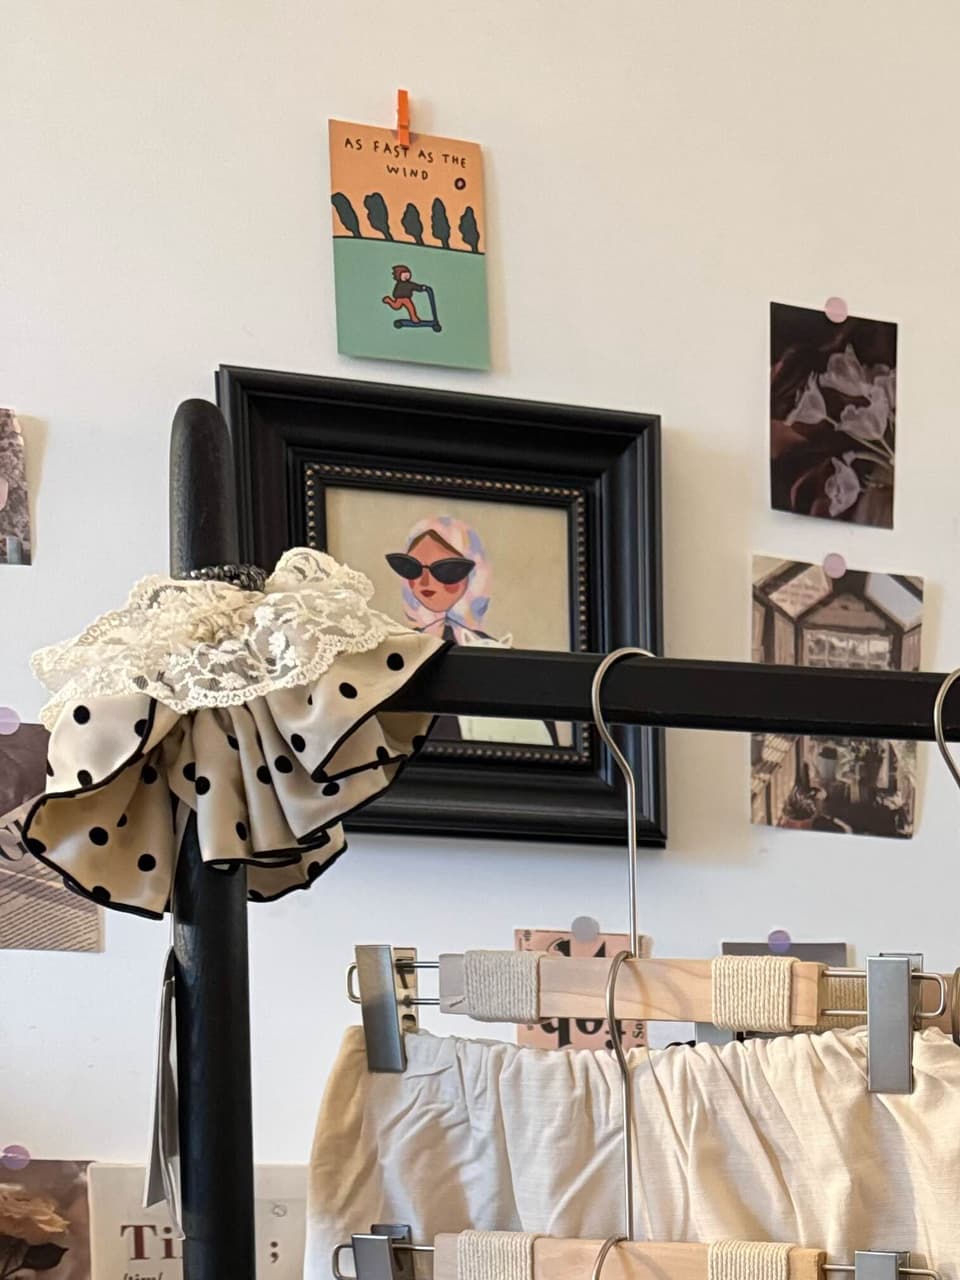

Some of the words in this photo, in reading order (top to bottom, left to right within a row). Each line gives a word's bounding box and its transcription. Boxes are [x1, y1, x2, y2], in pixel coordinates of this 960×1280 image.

[344, 138, 363, 150] AS
[373, 141, 410, 158] FAST
[418, 150, 434, 163] AS
[442, 153, 467, 168] THE
[387, 164, 429, 180] WIND
